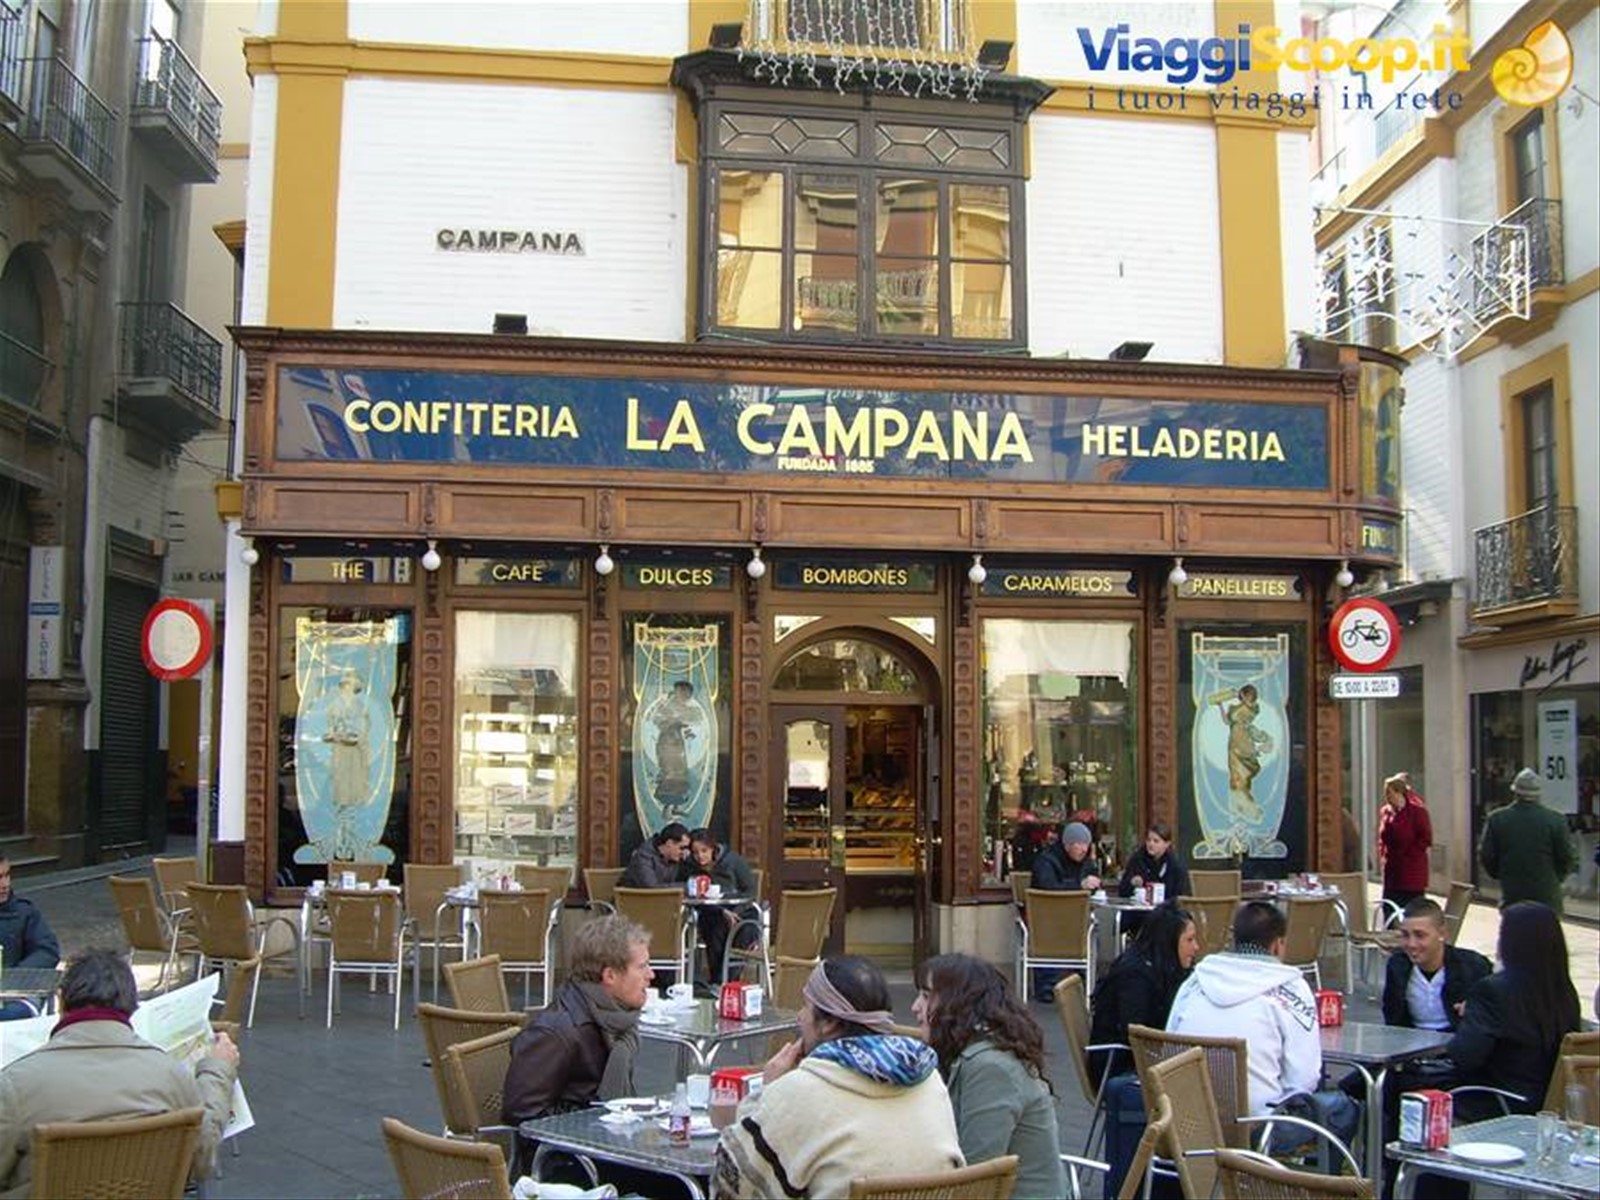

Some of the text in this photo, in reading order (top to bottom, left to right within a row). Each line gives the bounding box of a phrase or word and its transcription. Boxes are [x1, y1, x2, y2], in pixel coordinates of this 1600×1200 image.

[437, 229, 582, 251] CAMPANA
[344, 397, 1285, 463] CONFITERIA LA CAMPANA HELADERIA
[778, 457, 836, 471] FUNDADA
[331, 562, 364, 579] THE
[639, 567, 713, 585] DULCES
[803, 568, 908, 585] BOMBONES
[1004, 575, 1113, 592] CARAMELOS
[1193, 578, 1287, 596] PANELLETES
[1546, 756, 1565, 780] 50
